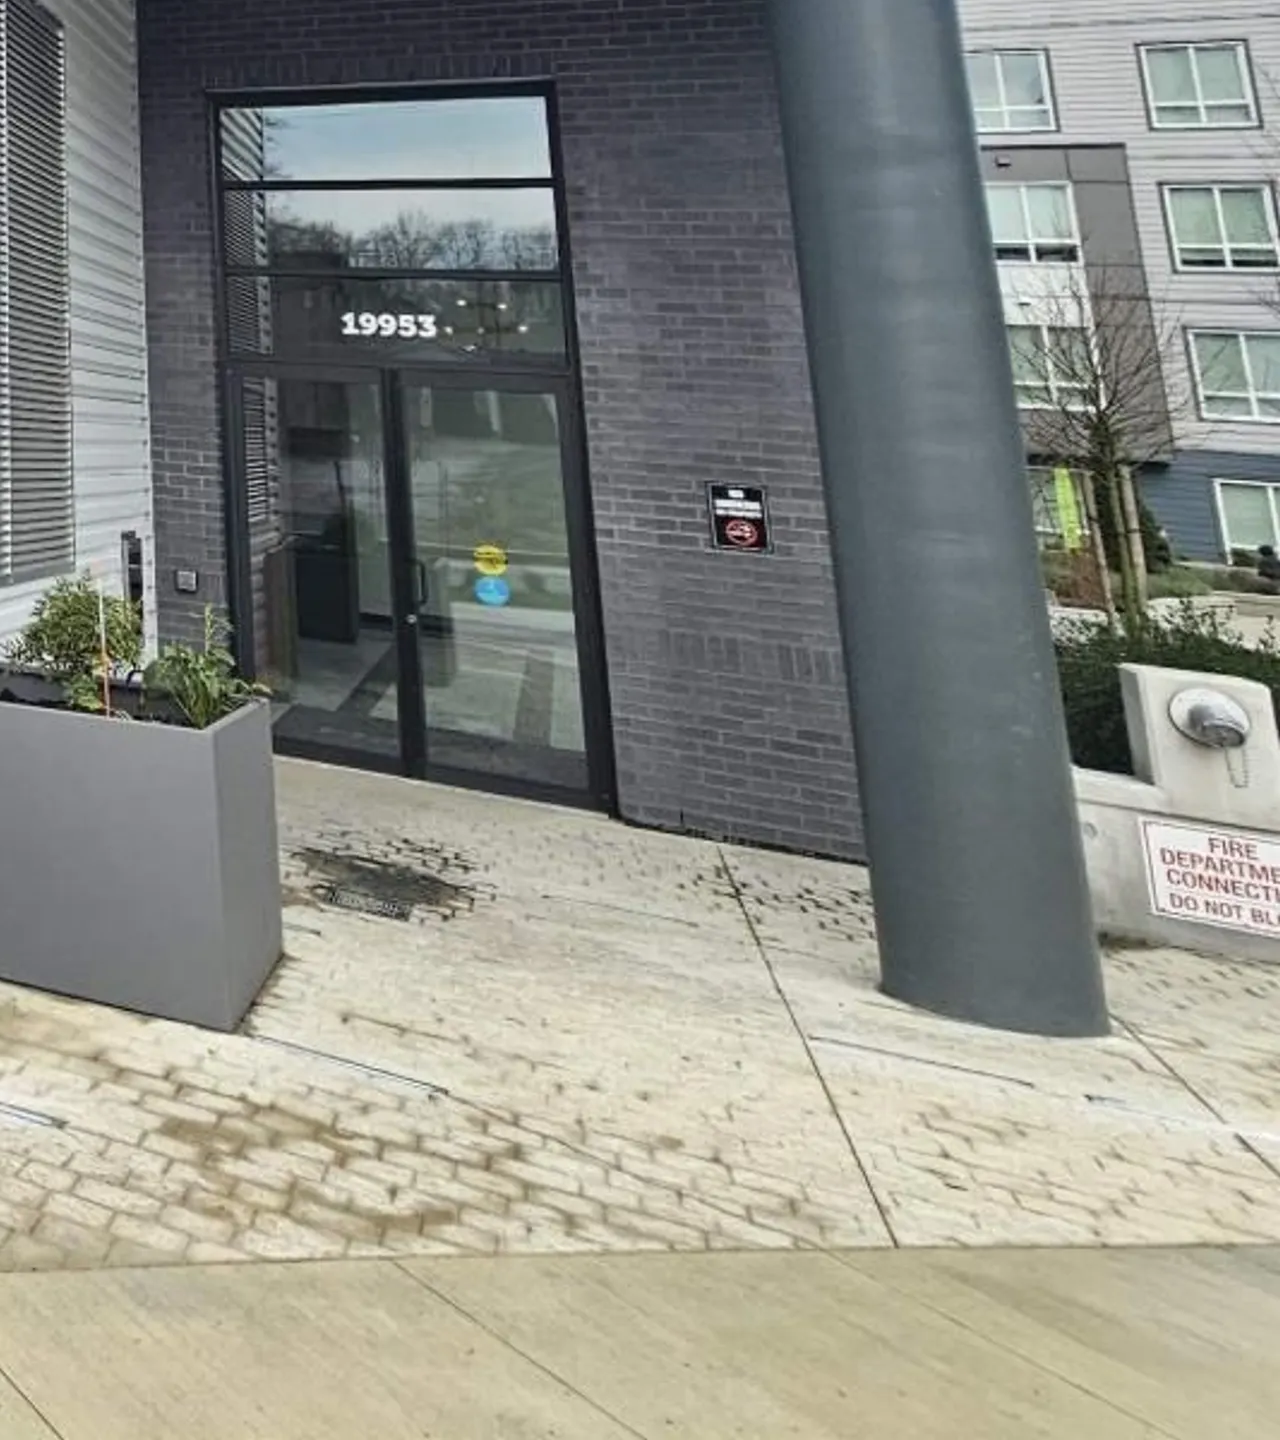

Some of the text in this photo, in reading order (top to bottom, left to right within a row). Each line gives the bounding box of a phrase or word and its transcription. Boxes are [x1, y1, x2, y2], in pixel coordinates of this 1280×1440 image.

[341, 312, 437, 337] 19953
[1208, 838, 1258, 860] FIRE
[1169, 893, 1280, 926] DO NOT BL
